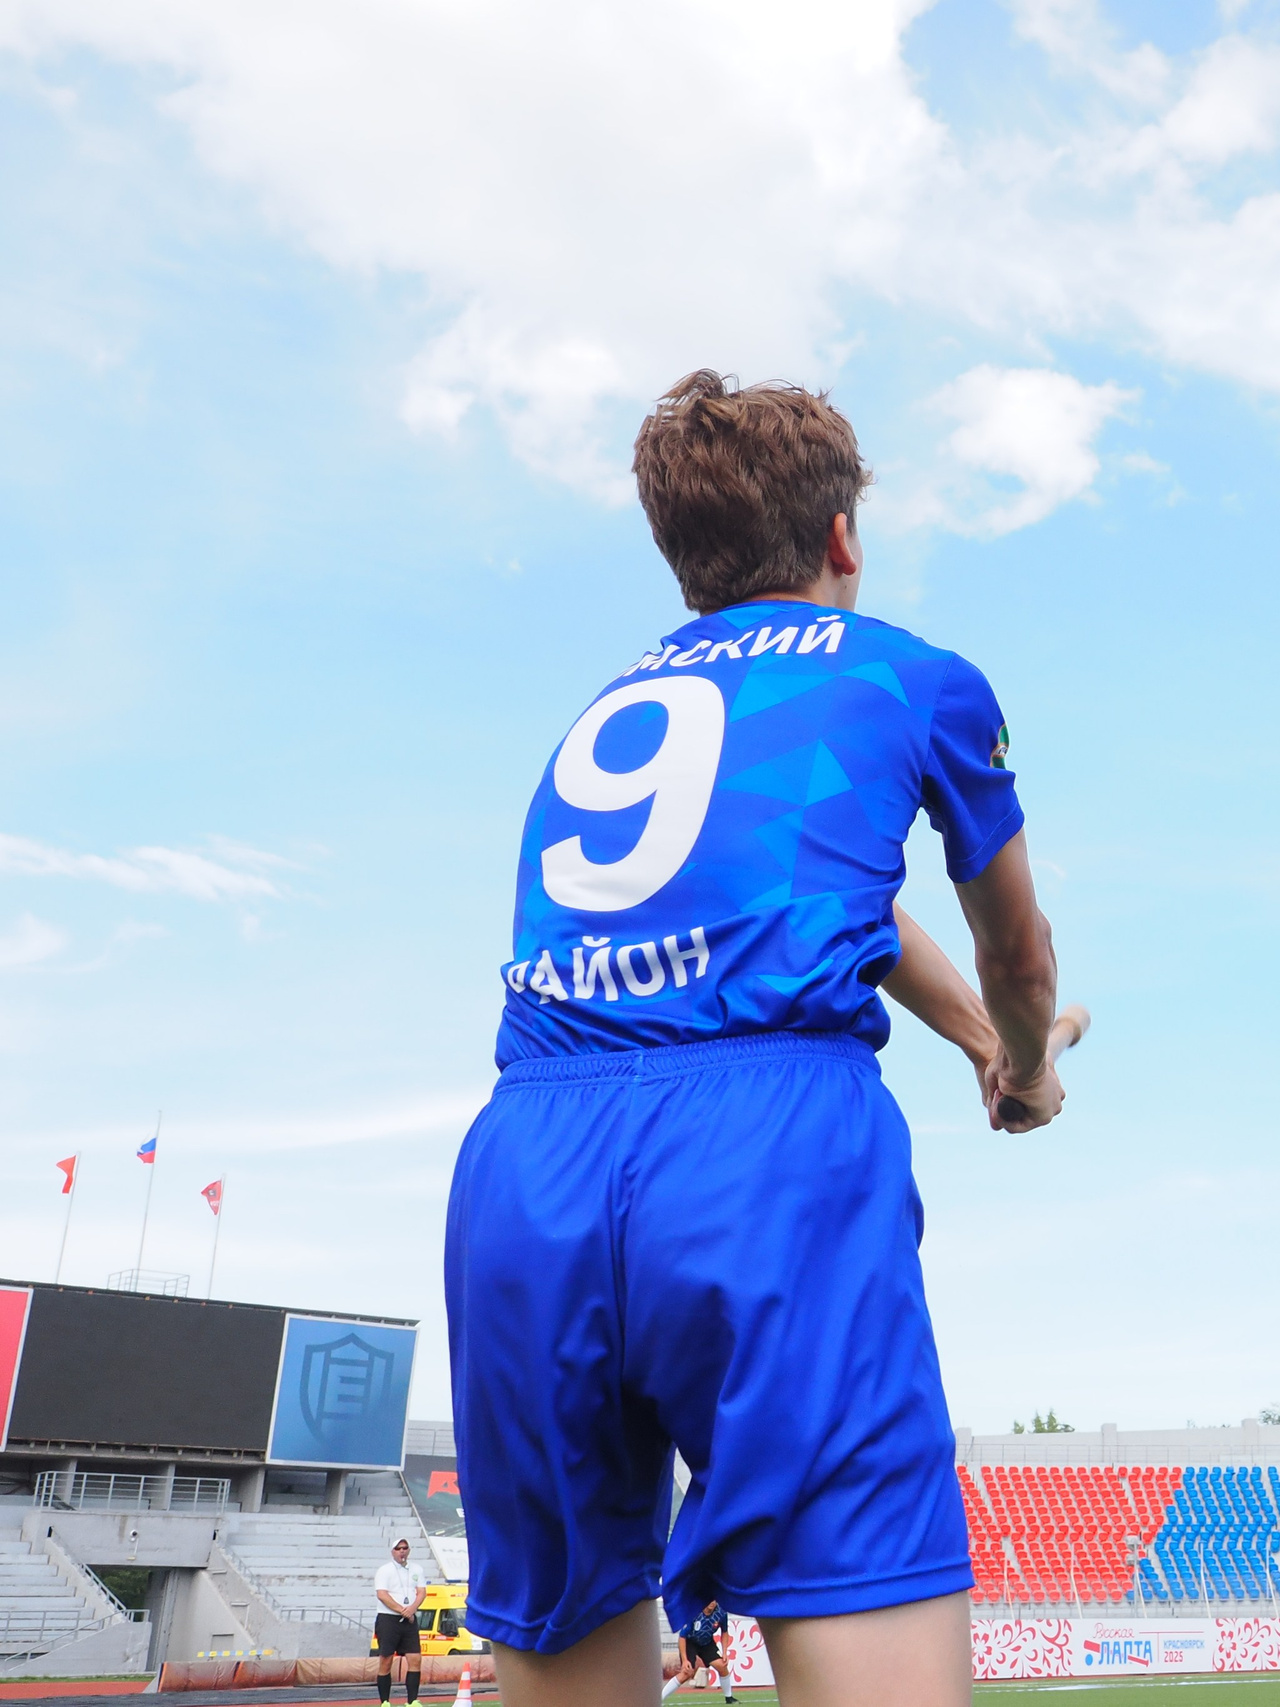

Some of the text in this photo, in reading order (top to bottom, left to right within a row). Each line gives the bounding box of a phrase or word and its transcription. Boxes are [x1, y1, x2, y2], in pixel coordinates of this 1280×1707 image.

[541, 675, 725, 912] 9
[1098, 1640, 1153, 1665] ЛАПТА
[1163, 1640, 1205, 1649] КРАСНОЯРСК
[1164, 1651, 1184, 1663] 2025
